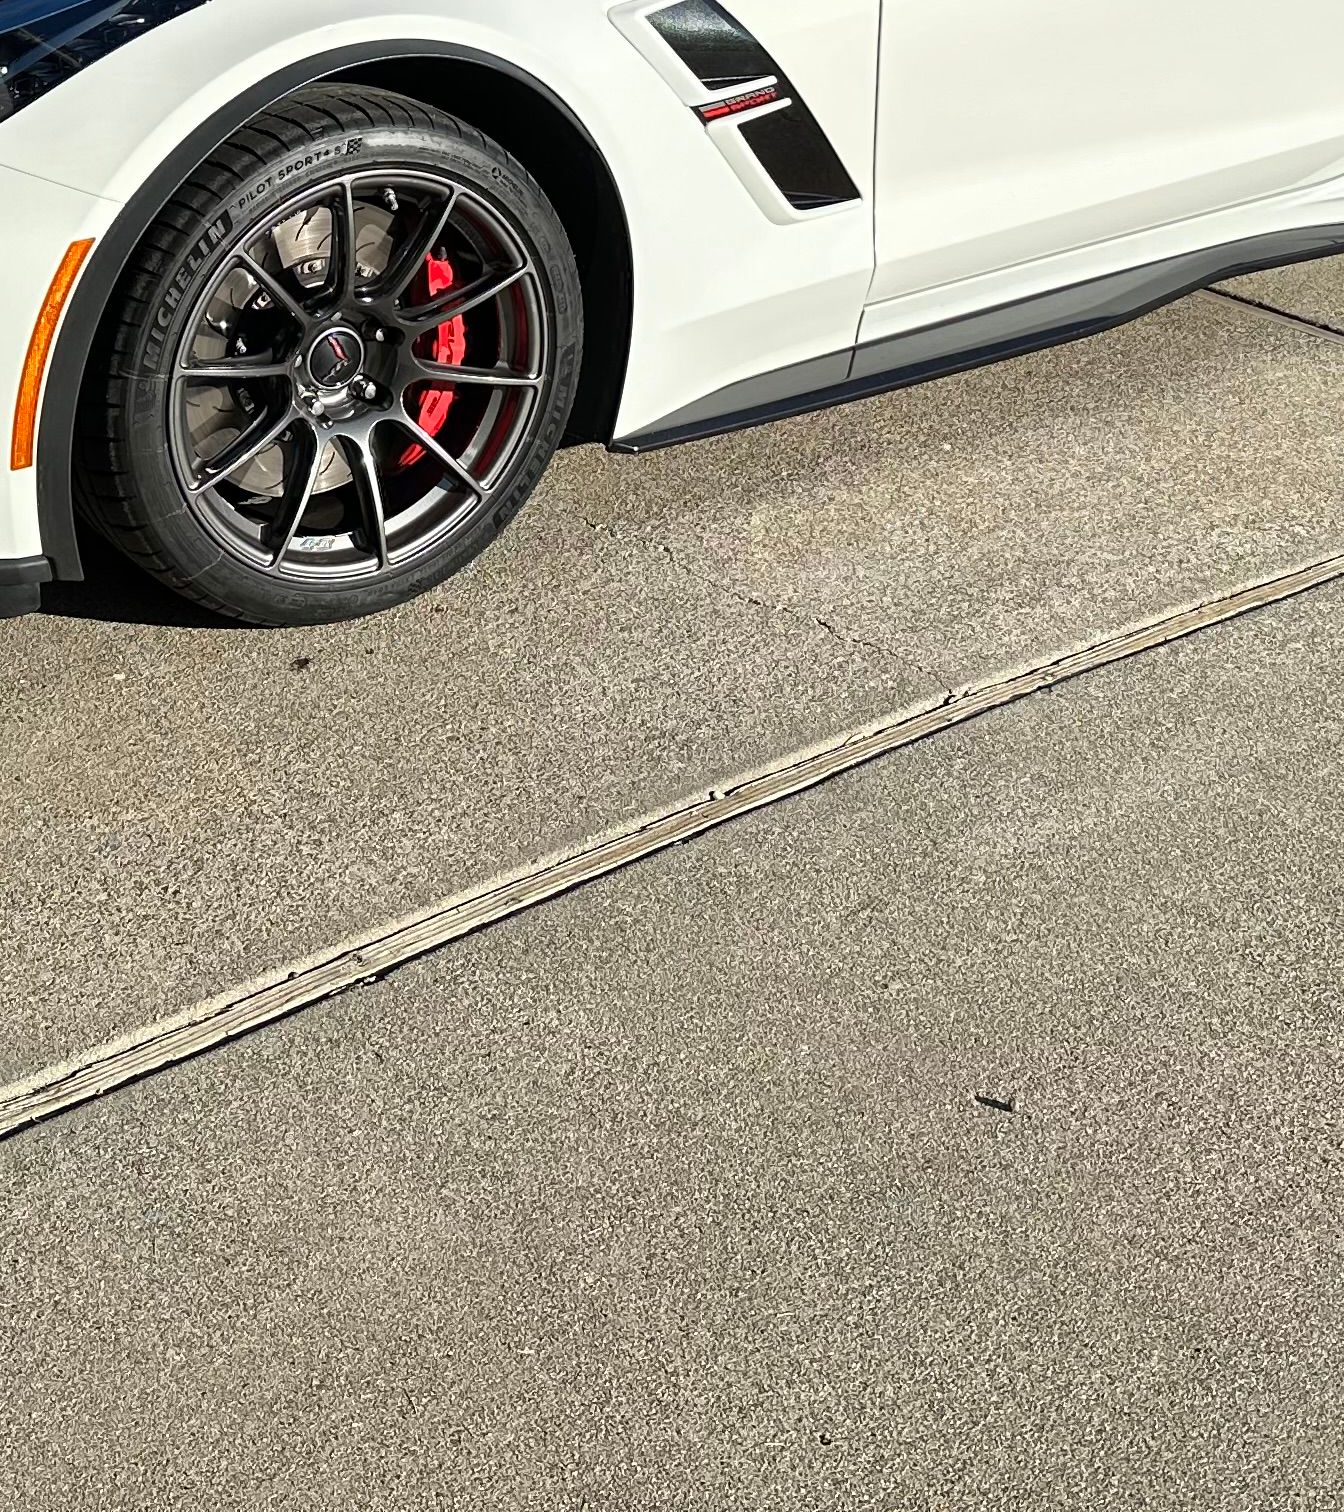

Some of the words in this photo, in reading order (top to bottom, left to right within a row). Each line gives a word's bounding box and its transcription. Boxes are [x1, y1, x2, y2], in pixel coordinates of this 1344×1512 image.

[725, 87, 776, 105] GRAND
[238, 176, 273, 209] PILOT
[277, 152, 322, 180] SPORT
[143, 219, 227, 371] MICHELIN
